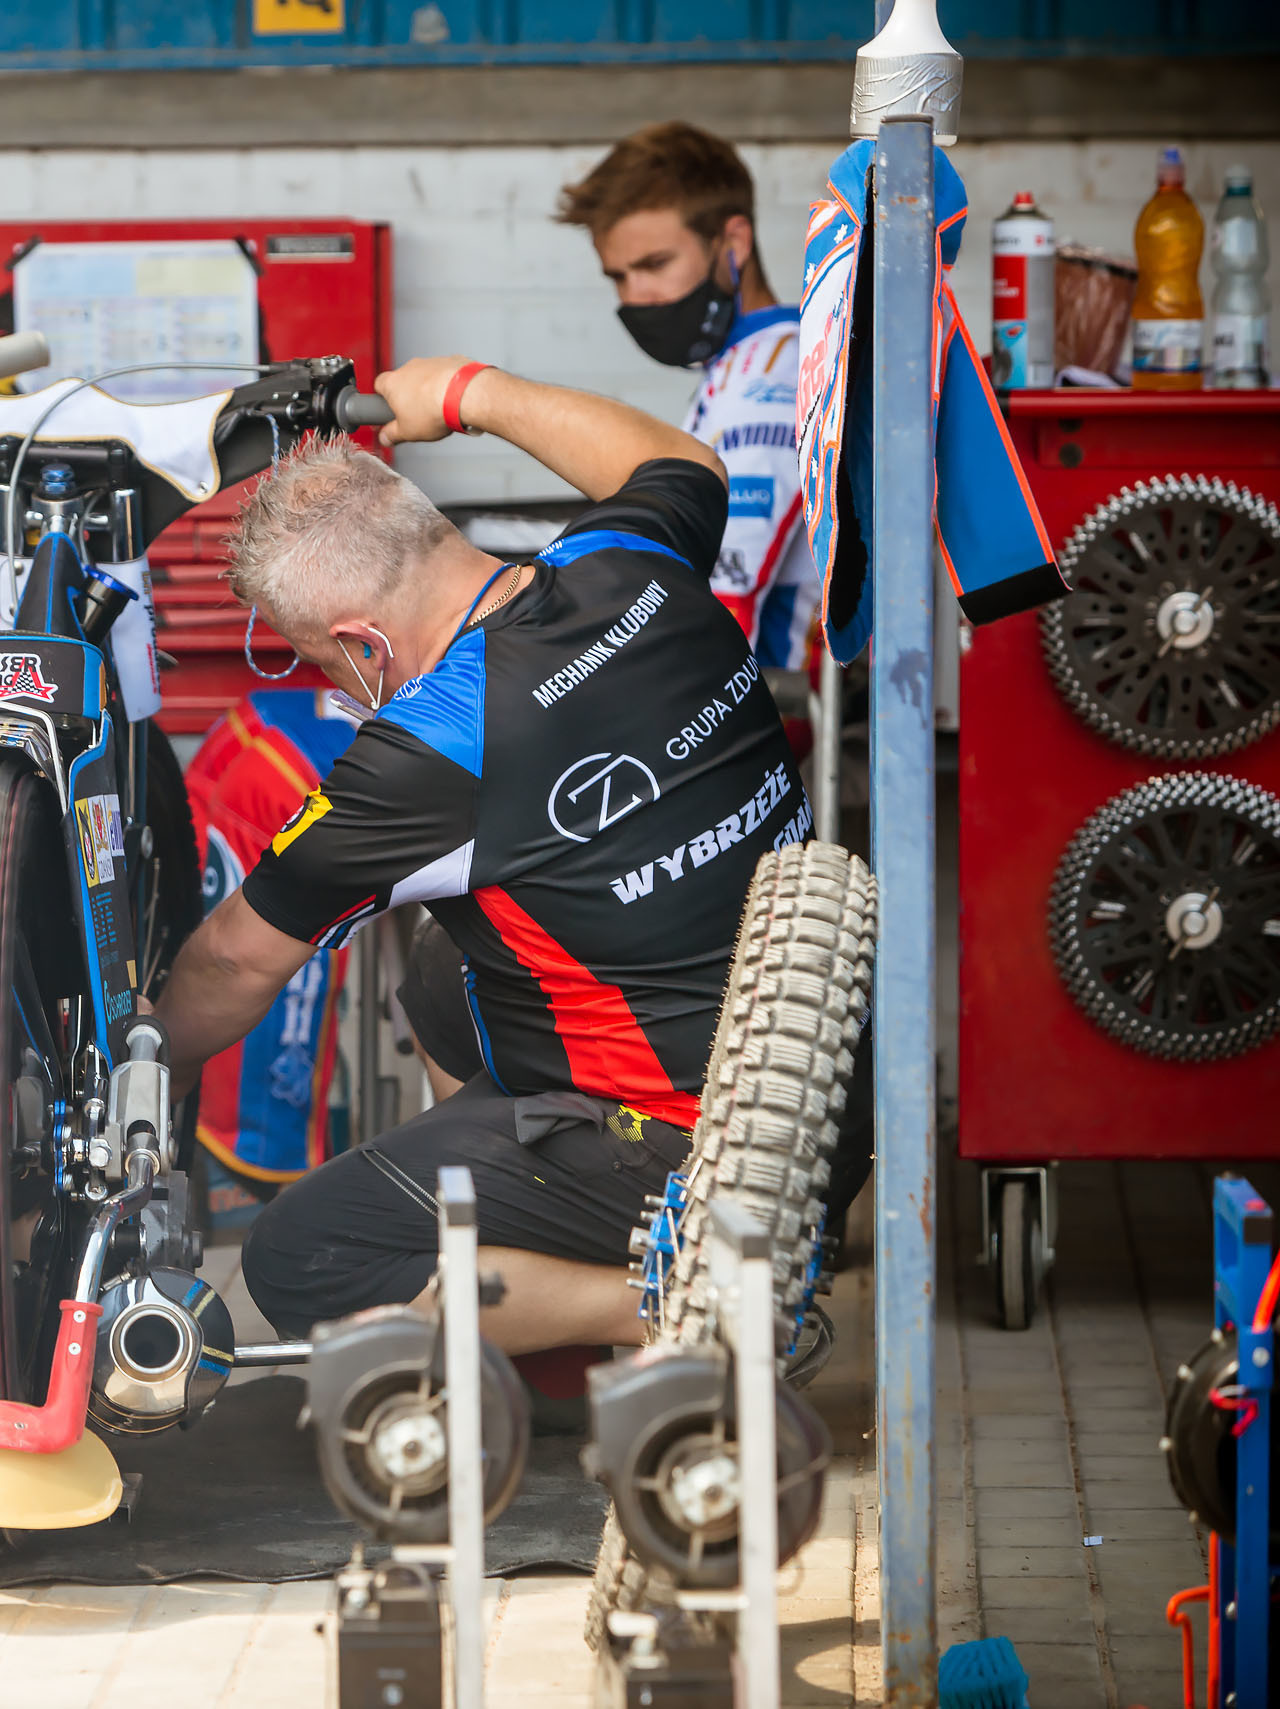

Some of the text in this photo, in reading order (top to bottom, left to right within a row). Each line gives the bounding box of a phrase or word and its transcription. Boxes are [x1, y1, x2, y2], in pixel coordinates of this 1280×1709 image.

[532, 579, 669, 708] MECHANIK KLUBOWY
[666, 698, 732, 760] GRUPA
[609, 761, 791, 905] WYBRZEŻE
